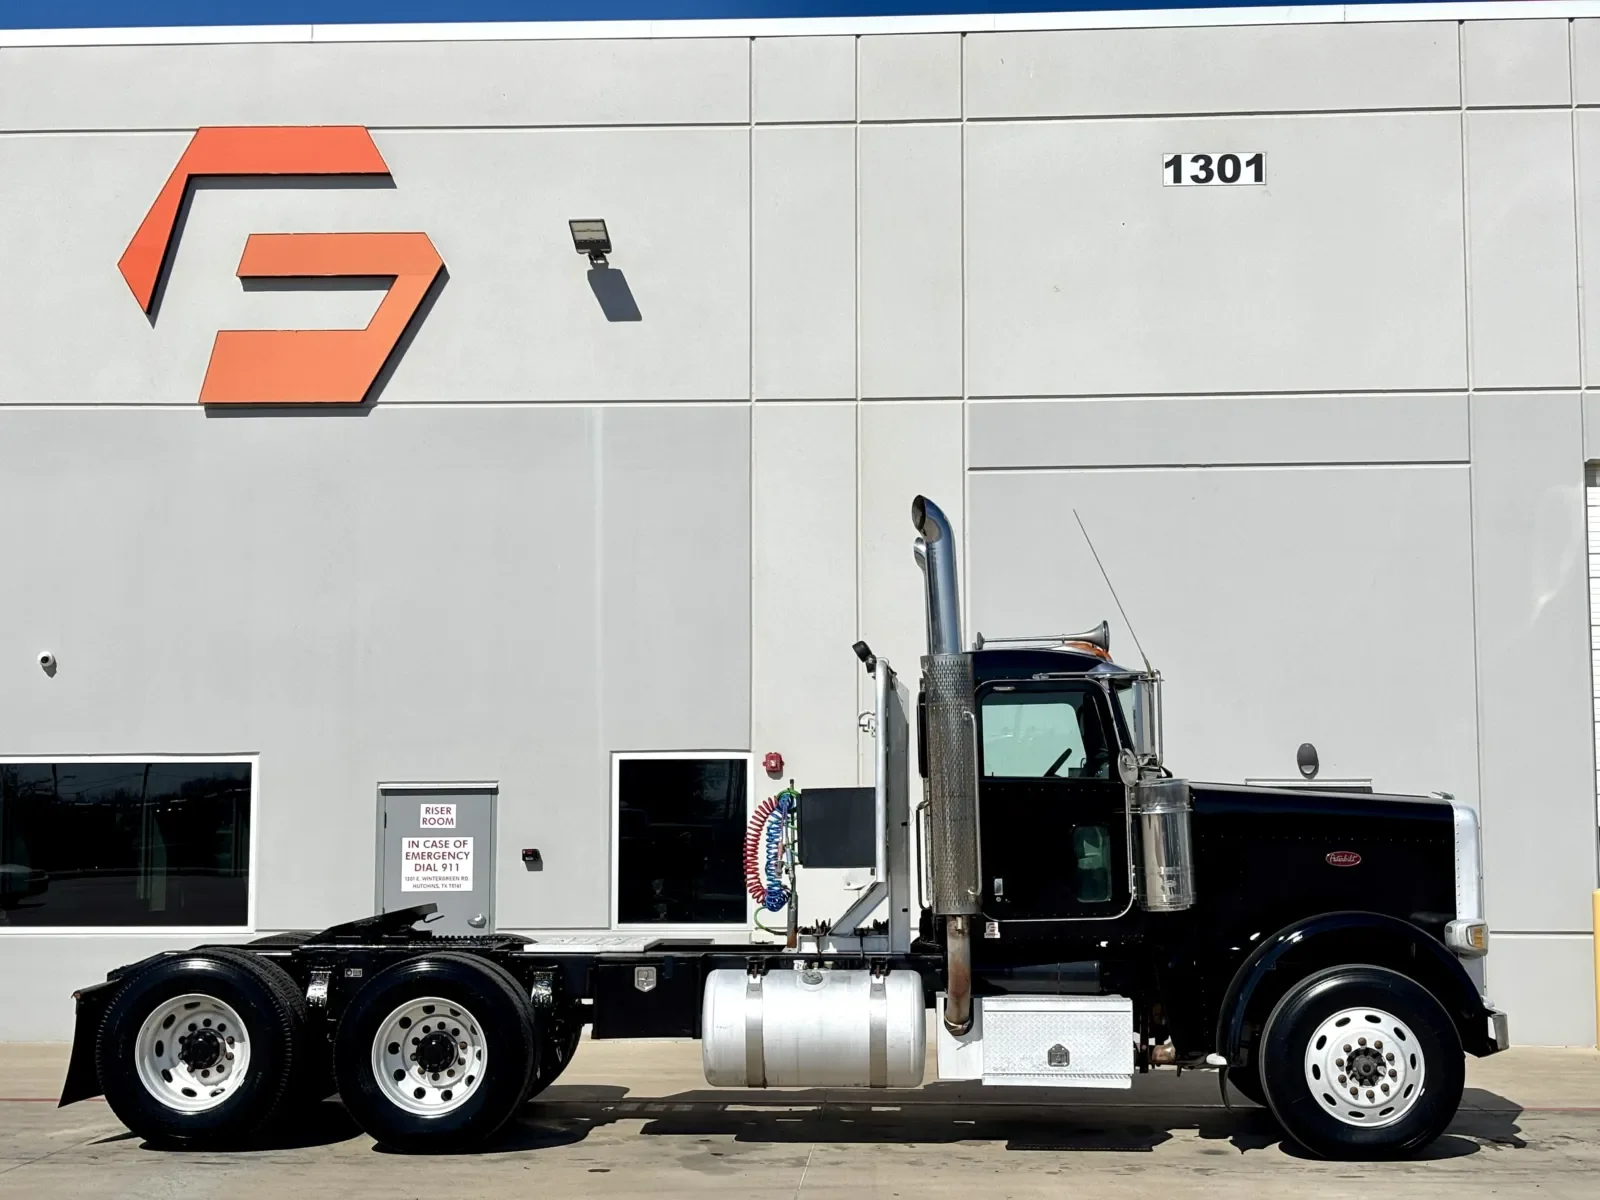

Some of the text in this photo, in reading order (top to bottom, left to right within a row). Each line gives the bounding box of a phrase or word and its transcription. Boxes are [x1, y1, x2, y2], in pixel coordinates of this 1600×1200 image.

[1164, 154, 1263, 184] 1301
[425, 806, 452, 814] RISER
[422, 817, 454, 826] ROOM
[408, 840, 468, 848] IN CASE OF
[405, 852, 470, 860] EMERGENCY
[414, 863, 459, 872] DIAL 911
